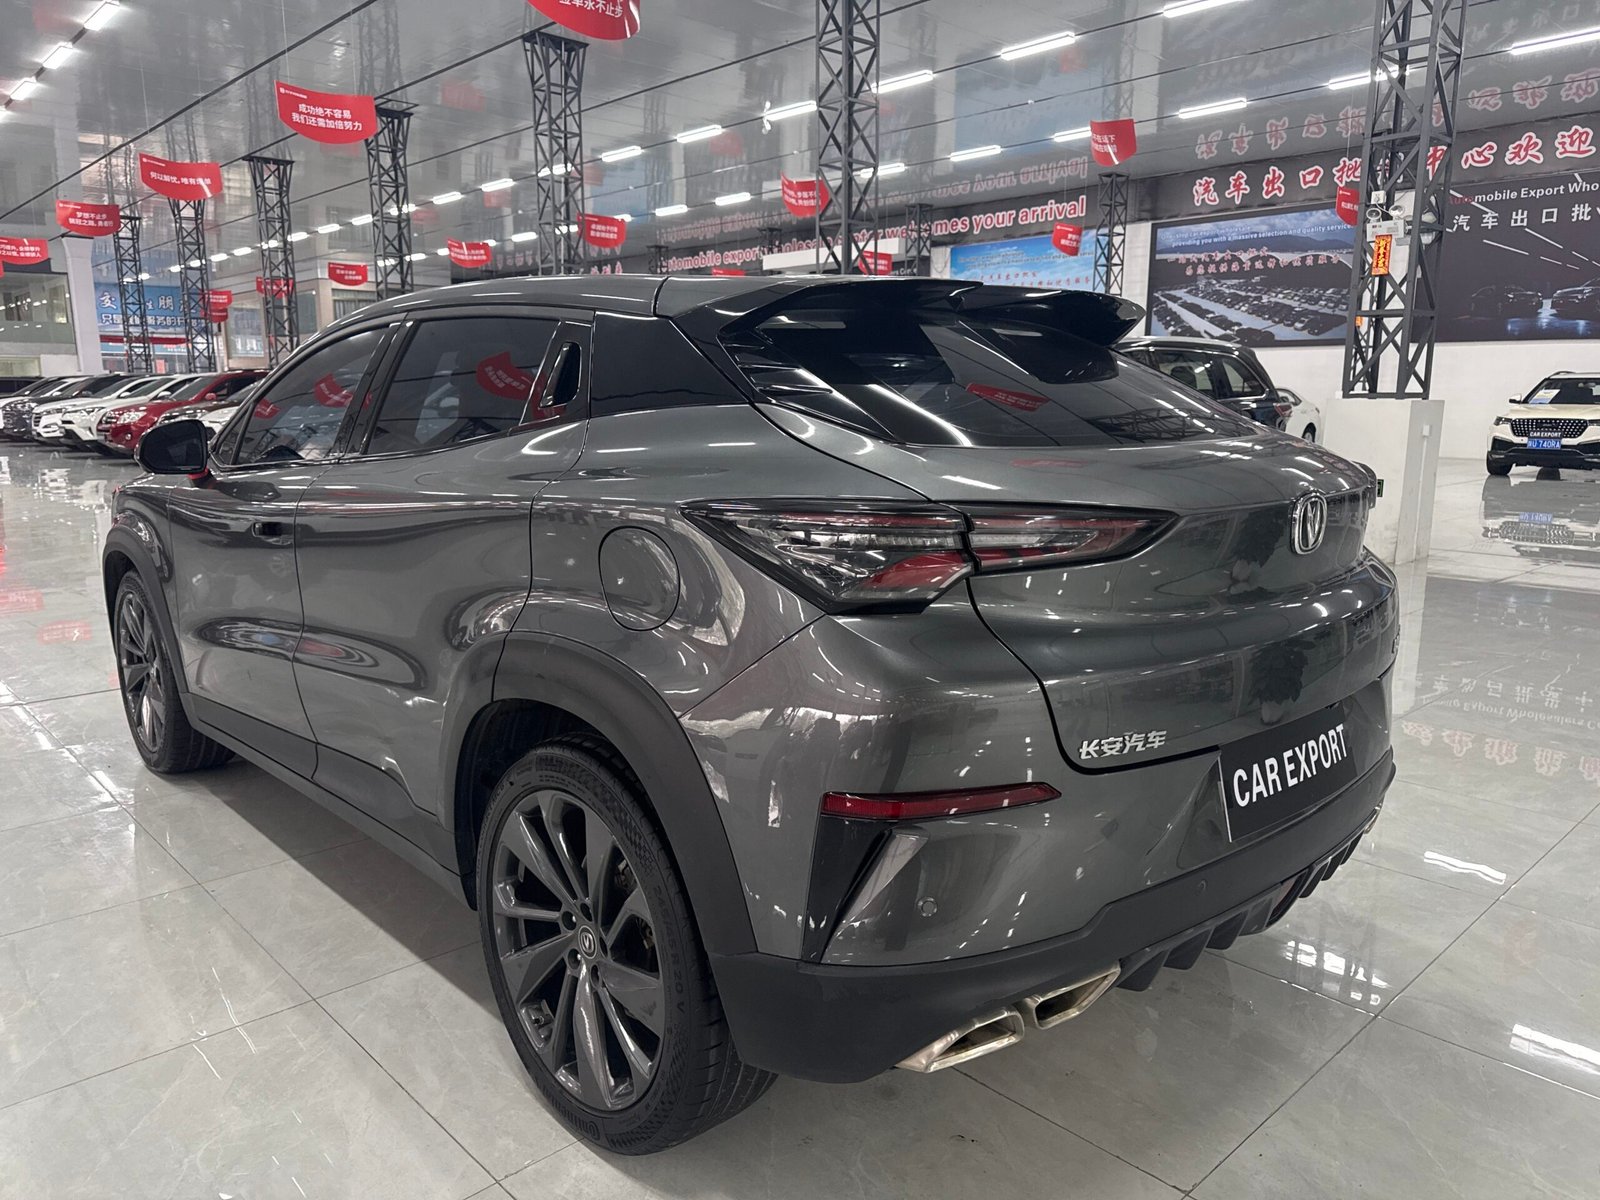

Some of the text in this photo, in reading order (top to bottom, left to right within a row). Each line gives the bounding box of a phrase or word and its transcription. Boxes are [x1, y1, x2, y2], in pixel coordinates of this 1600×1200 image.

[291, 112, 362, 130] 我们还需加倍努力
[298, 103, 352, 119] 成功绝不容易
[1521, 184, 1566, 199] Export
[972, 209, 1017, 235] your
[1018, 194, 1088, 225] arrival
[1453, 203, 1600, 232] 汽车出口批
[1258, 229, 1288, 238] selection
[1288, 227, 1301, 235] and
[1302, 225, 1325, 234] quality
[1079, 730, 1168, 760] 长安汽车
[1233, 757, 1282, 807] CAR
[1286, 723, 1348, 788] EXPORT
